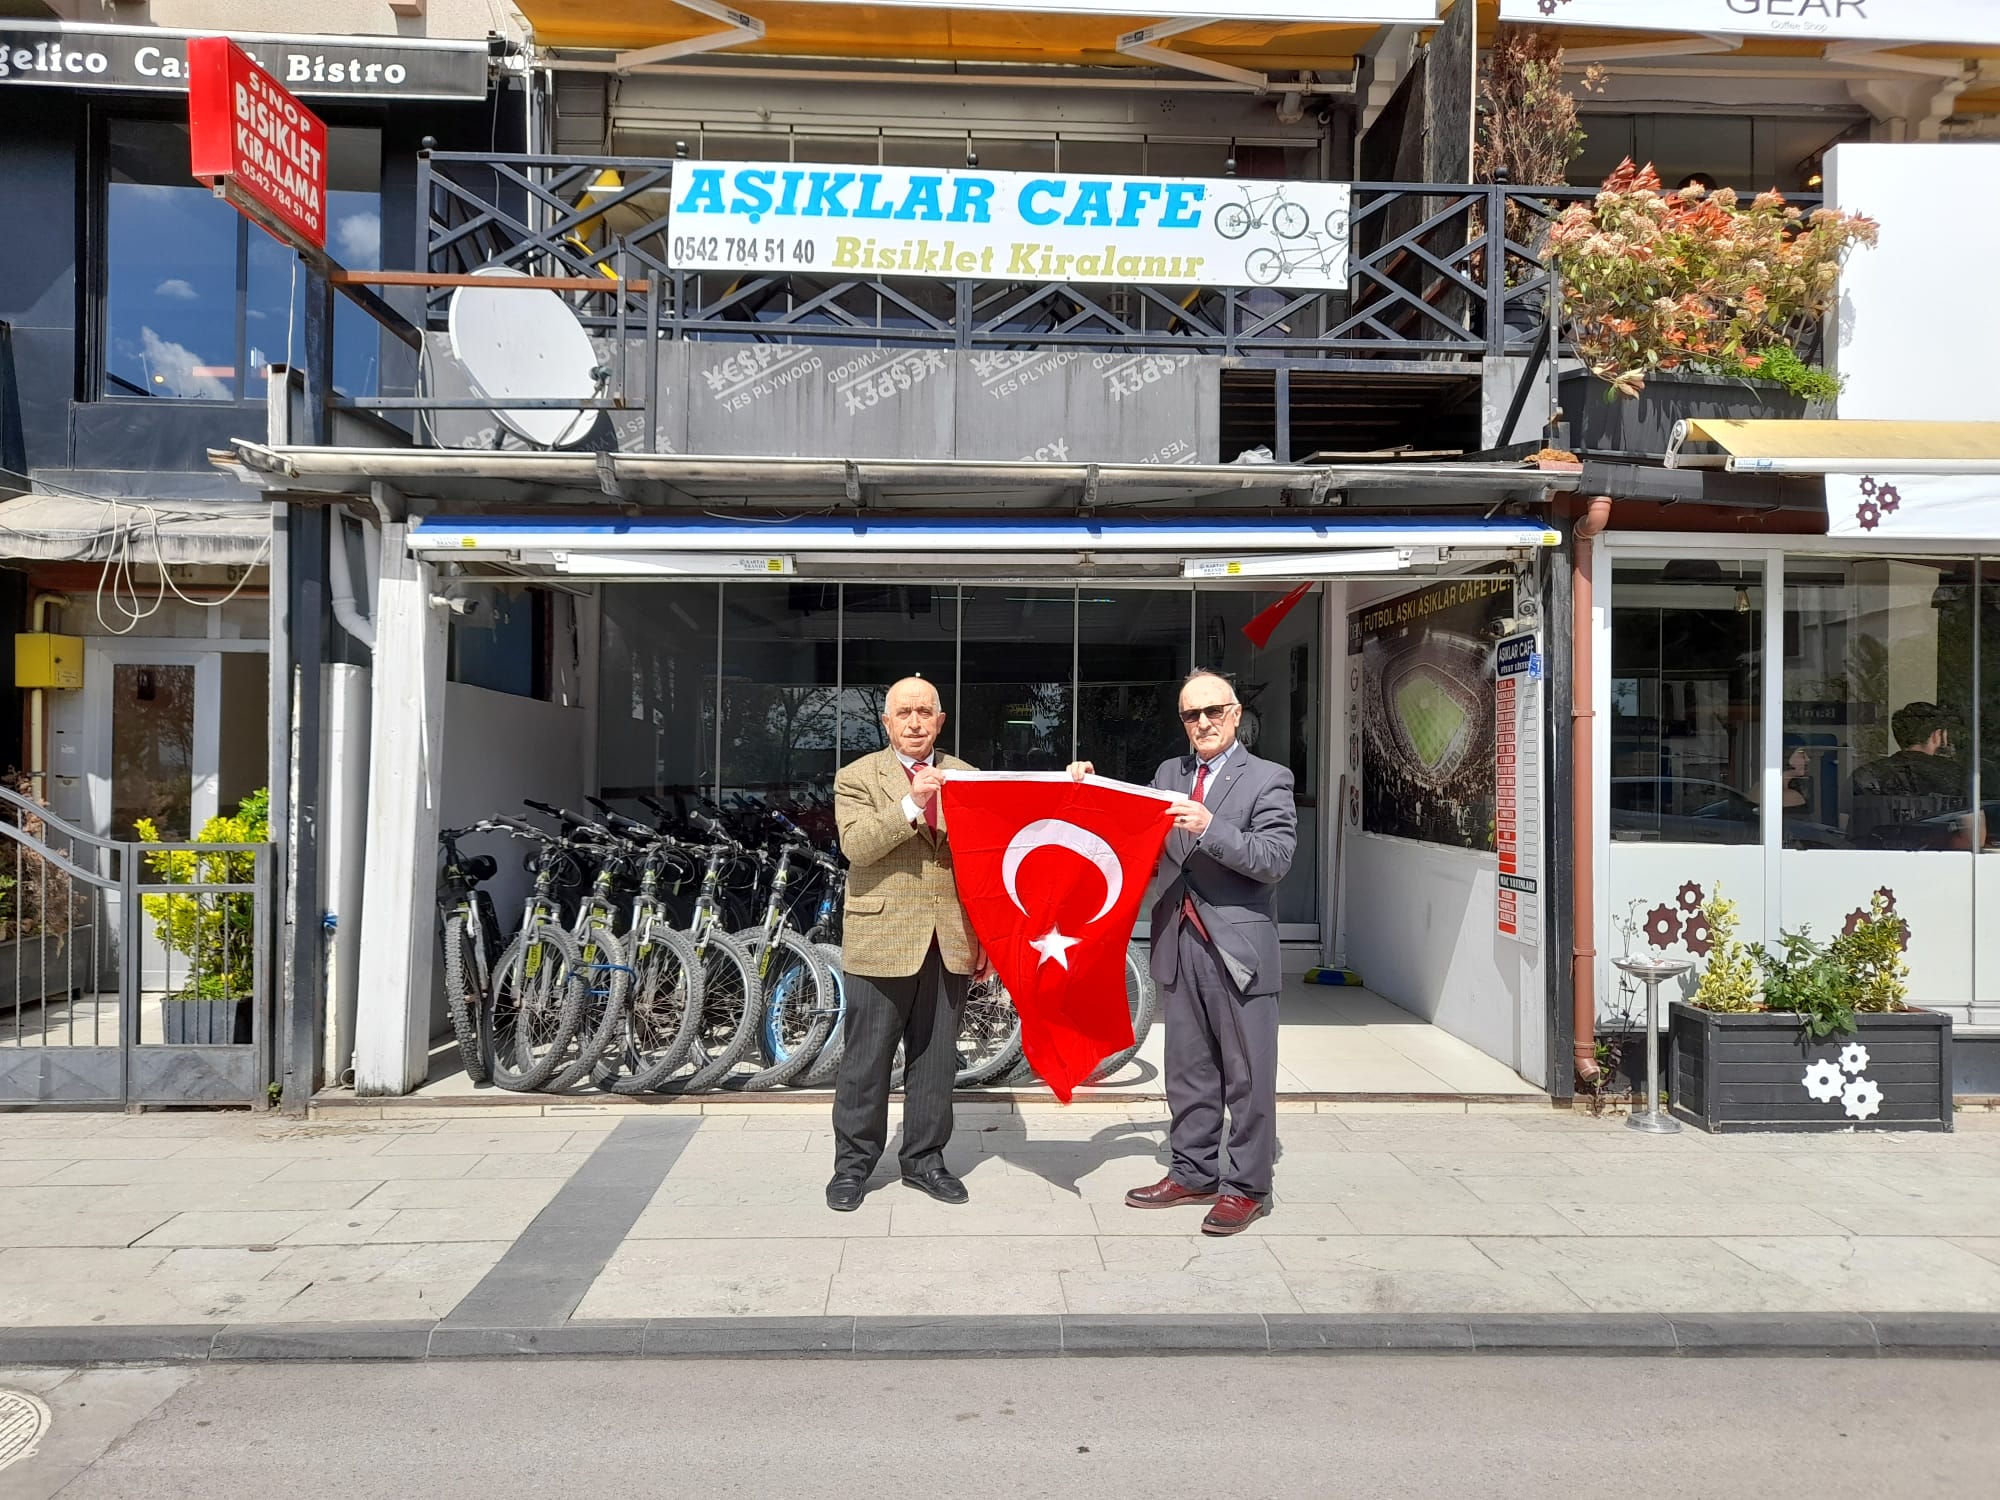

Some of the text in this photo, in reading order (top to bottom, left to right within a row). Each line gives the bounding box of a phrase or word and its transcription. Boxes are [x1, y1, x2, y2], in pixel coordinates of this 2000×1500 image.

[1771, 20, 1828, 32] Coffee Shop
[286, 54, 406, 84] Bistro
[242, 160, 318, 231] 0542 784 51 40
[676, 169, 1206, 228] AŞIKLAR CAFE
[674, 236, 1205, 278] 0542 784 51 40 Bisiklet Kiralanır
[722, 356, 822, 413] YES PLYWOOD
[989, 379, 1018, 399] YES
[1160, 440, 1189, 459] YES
[1364, 607, 1395, 632] FUTBOL
[1396, 601, 1416, 626] AŞKI
[1417, 586, 1457, 619] AŞIKLAR
